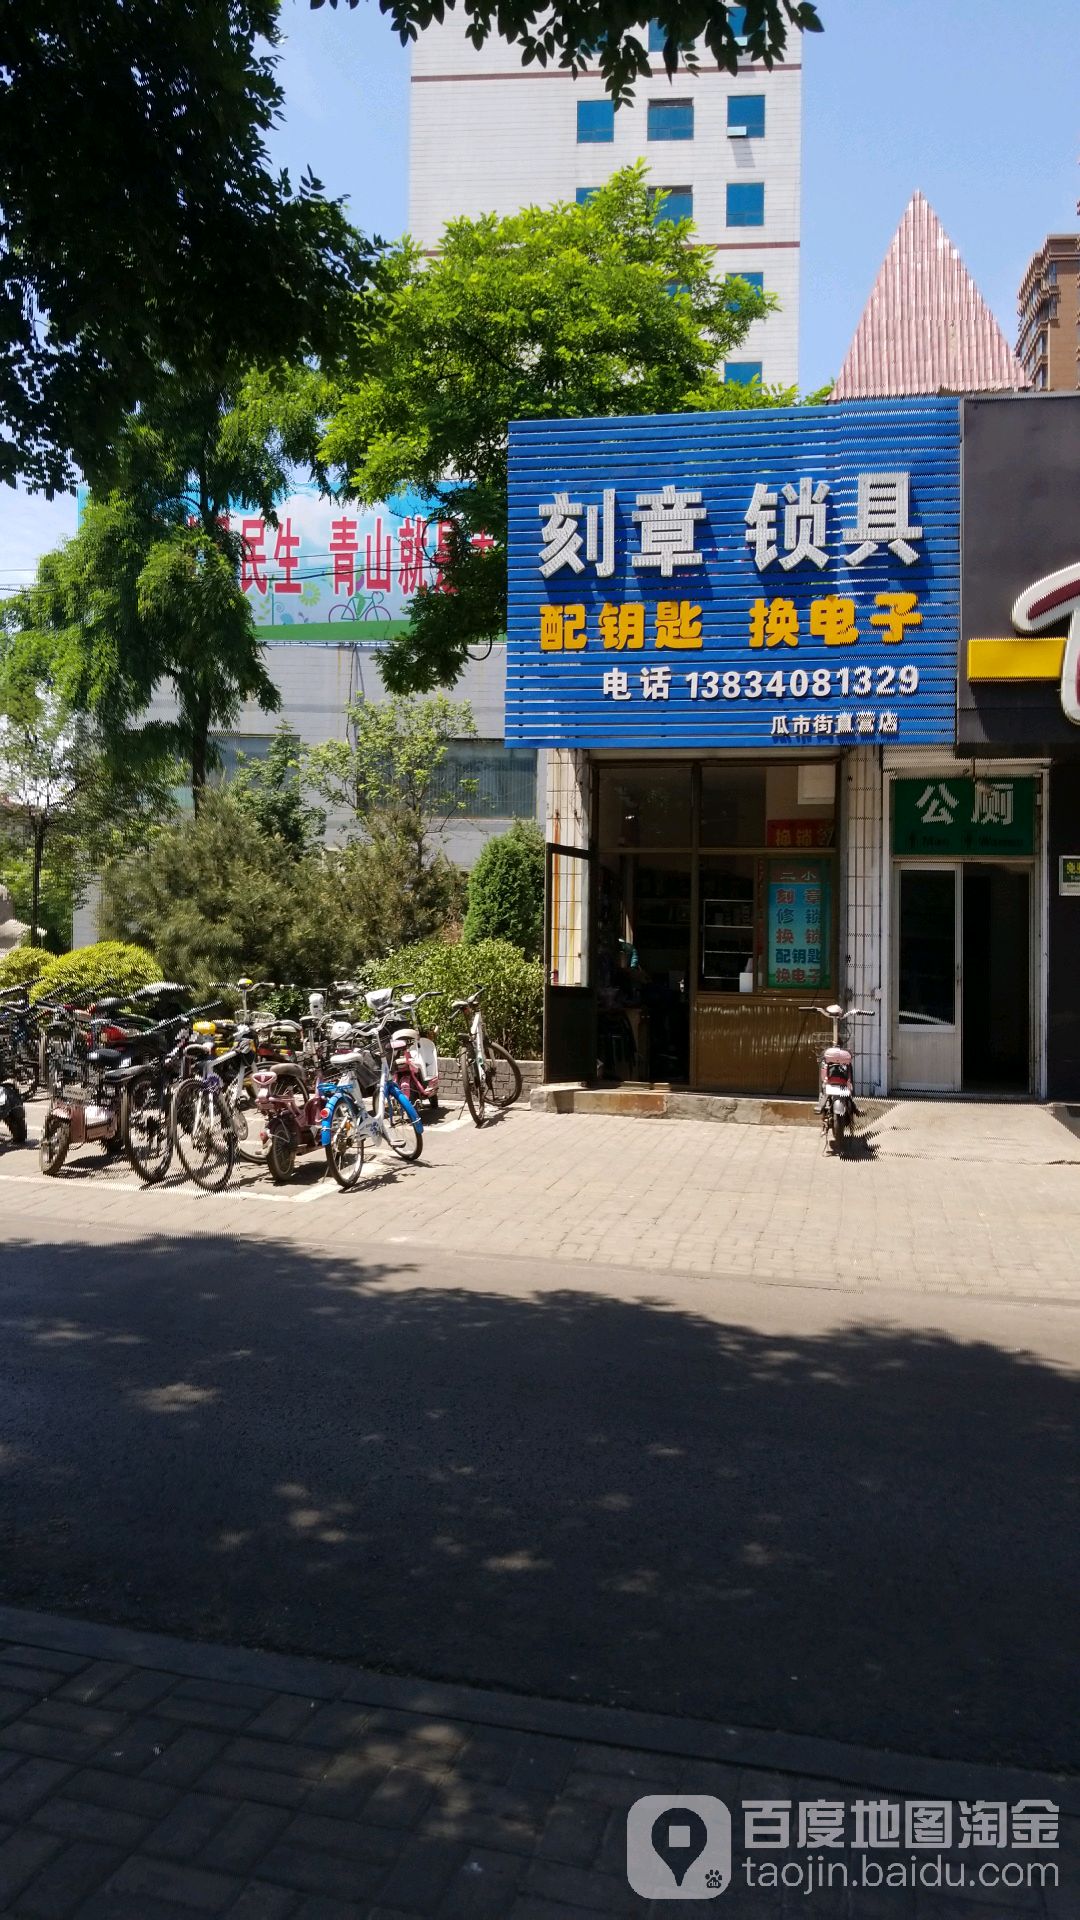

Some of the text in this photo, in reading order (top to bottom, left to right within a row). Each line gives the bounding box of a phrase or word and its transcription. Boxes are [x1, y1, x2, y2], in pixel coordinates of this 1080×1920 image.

[538, 471, 923, 578] 刻章 锁具
[539, 592, 923, 652] 配钥匙 换电子
[603, 664, 919, 702] 电话 13834081329
[770, 711, 898, 736] 瓜市街直营店
[914, 782, 1014, 825] 公厕
[776, 888, 822, 905] 刻章
[776, 907, 822, 924] 修锁
[776, 928, 822, 945] 换锁
[775, 948, 821, 964] 配钥匙
[776, 967, 822, 984] 换电子
